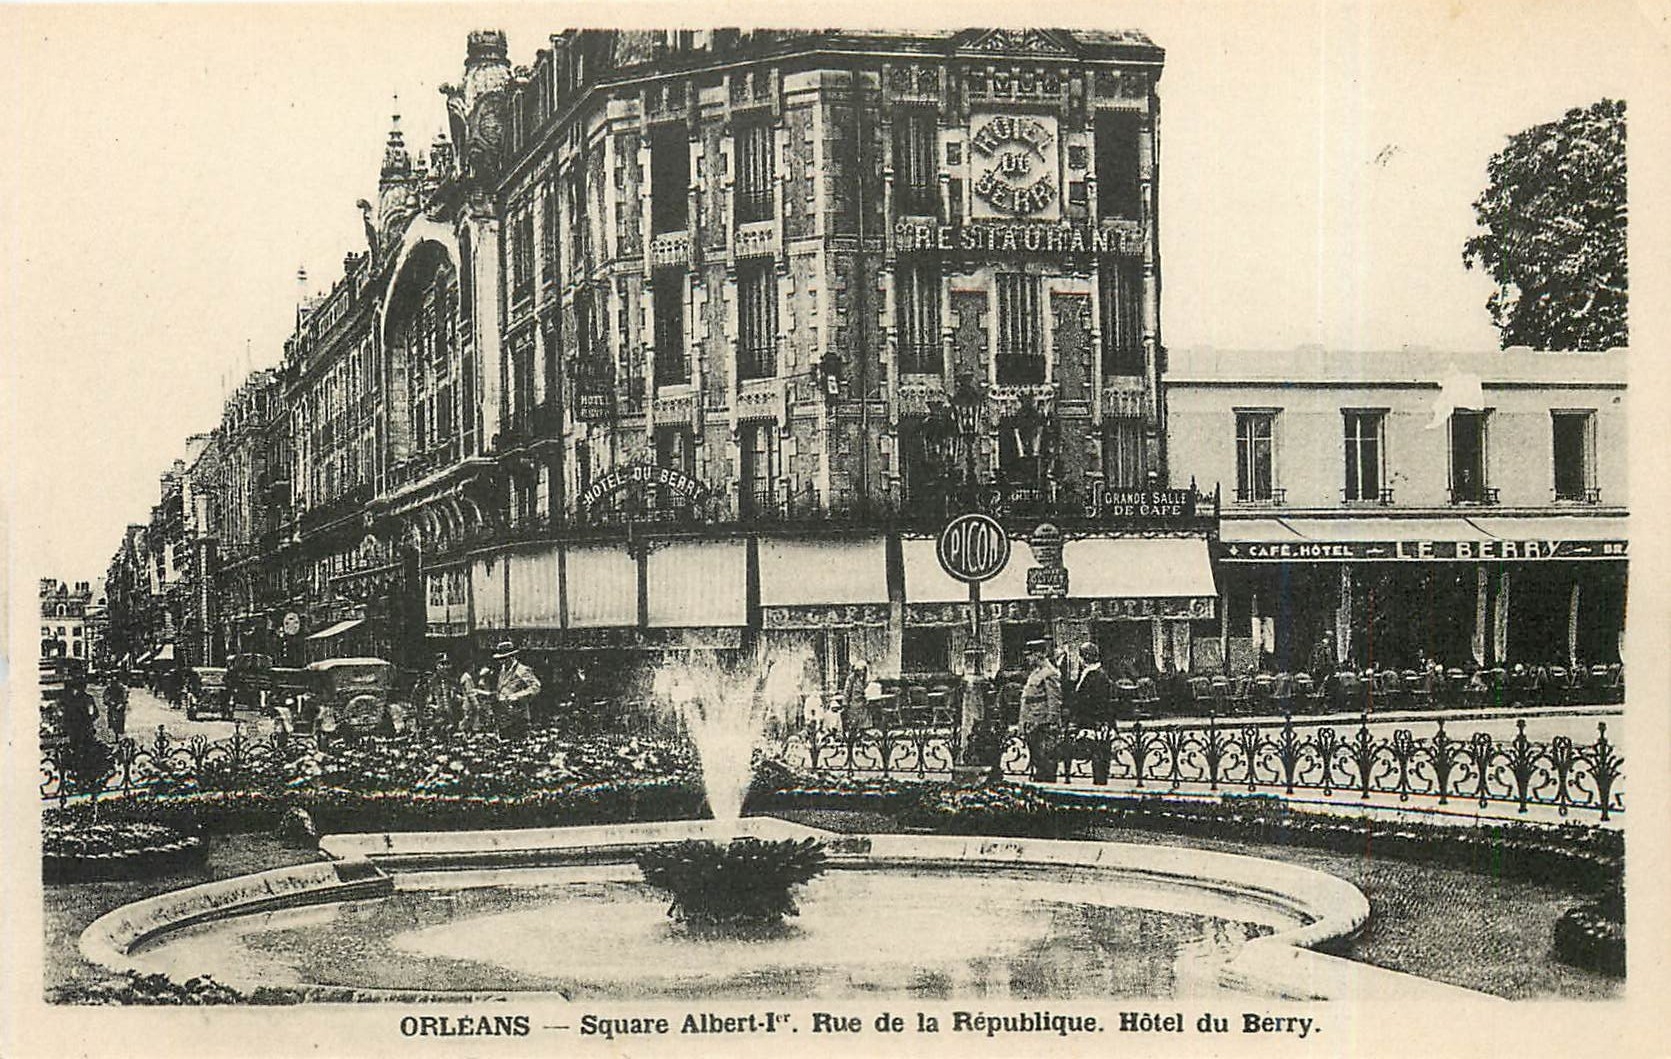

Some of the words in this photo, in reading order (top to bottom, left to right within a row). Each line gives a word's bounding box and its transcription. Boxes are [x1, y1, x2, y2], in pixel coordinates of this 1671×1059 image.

[915, 225, 1127, 252] RESTAURANT
[584, 472, 627, 506] HOTEL
[634, 467, 652, 480] DU
[660, 469, 703, 500] BERRY
[1105, 492, 1146, 504] GRANDE
[1152, 492, 1186, 504] SALLE
[1114, 505, 1134, 516] DE
[951, 521, 999, 572] PICON
[1396, 541, 1435, 558] LE
[1456, 541, 1561, 559] BERRY
